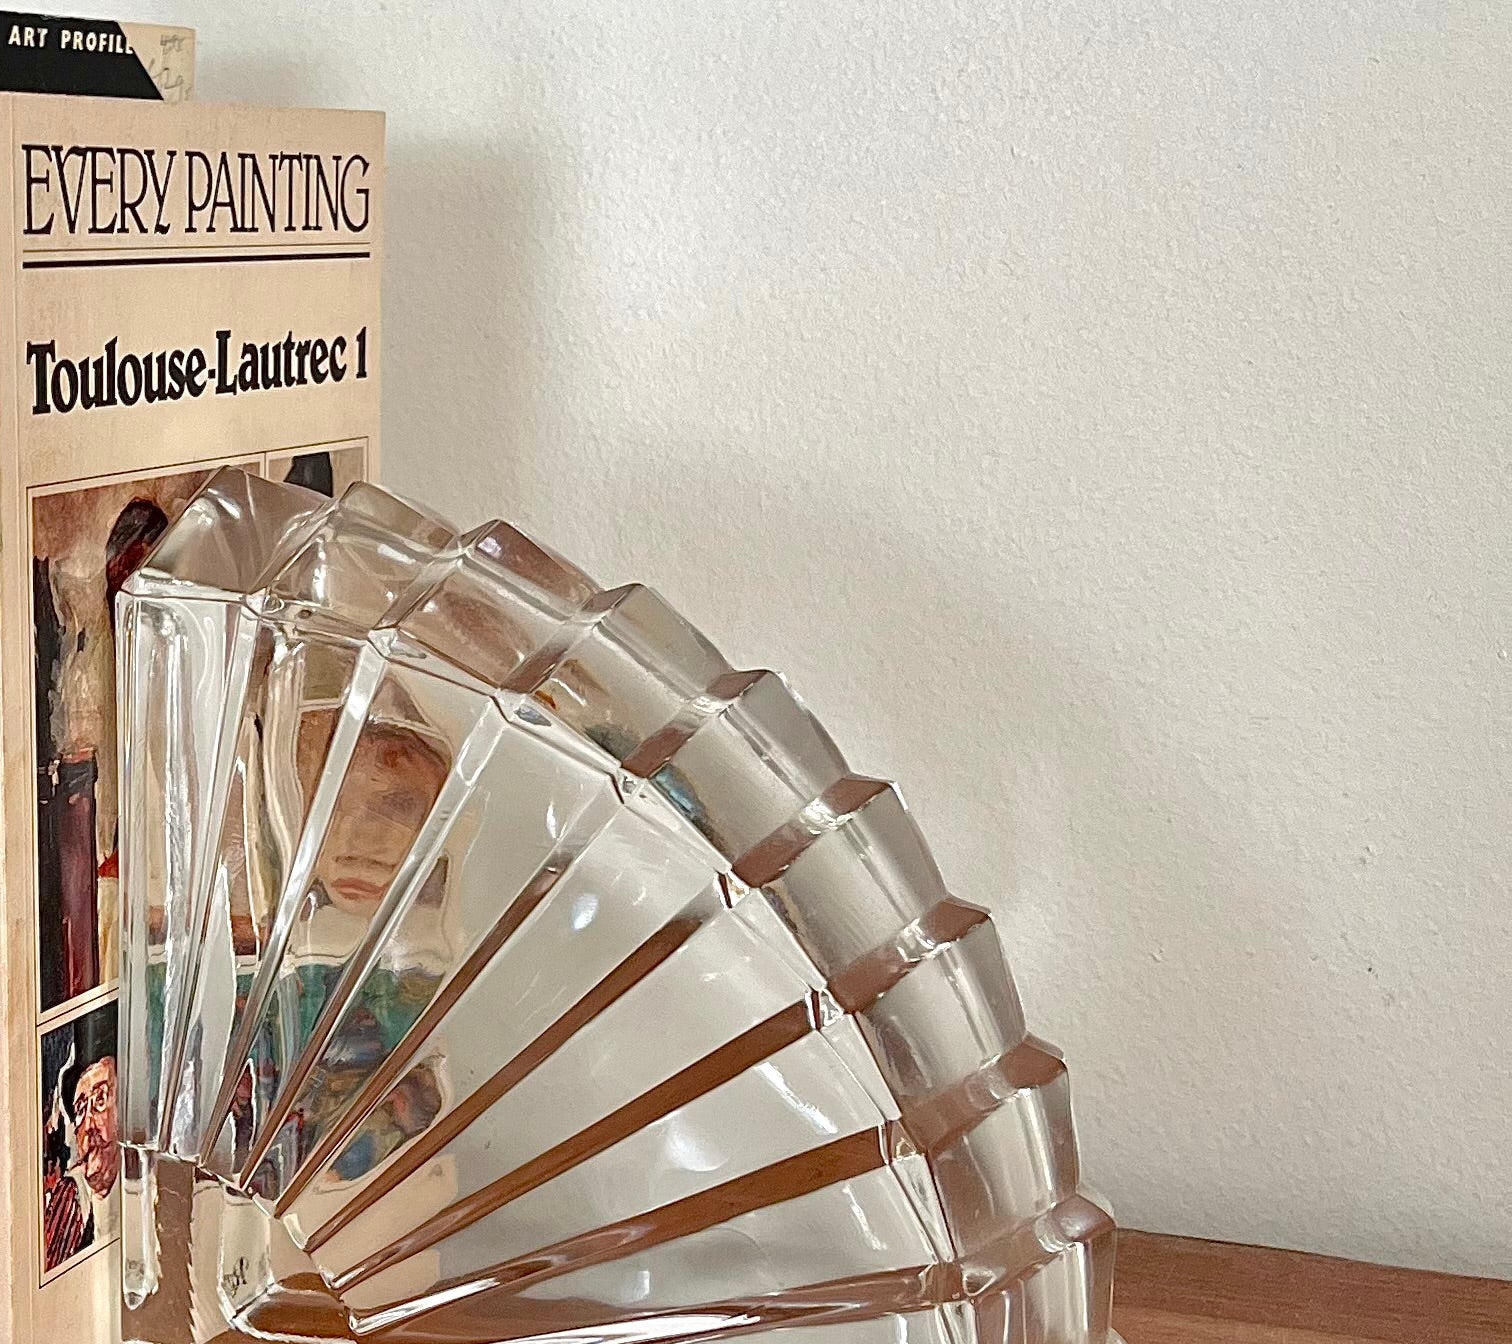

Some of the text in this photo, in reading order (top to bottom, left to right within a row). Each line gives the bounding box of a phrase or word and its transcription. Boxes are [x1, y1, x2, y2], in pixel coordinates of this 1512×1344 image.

[8, 28, 47, 48] ART
[21, 144, 177, 235] EVERY
[184, 149, 370, 233] PAINTING
[26, 326, 368, 416] Toulouse-Lautrec 1
